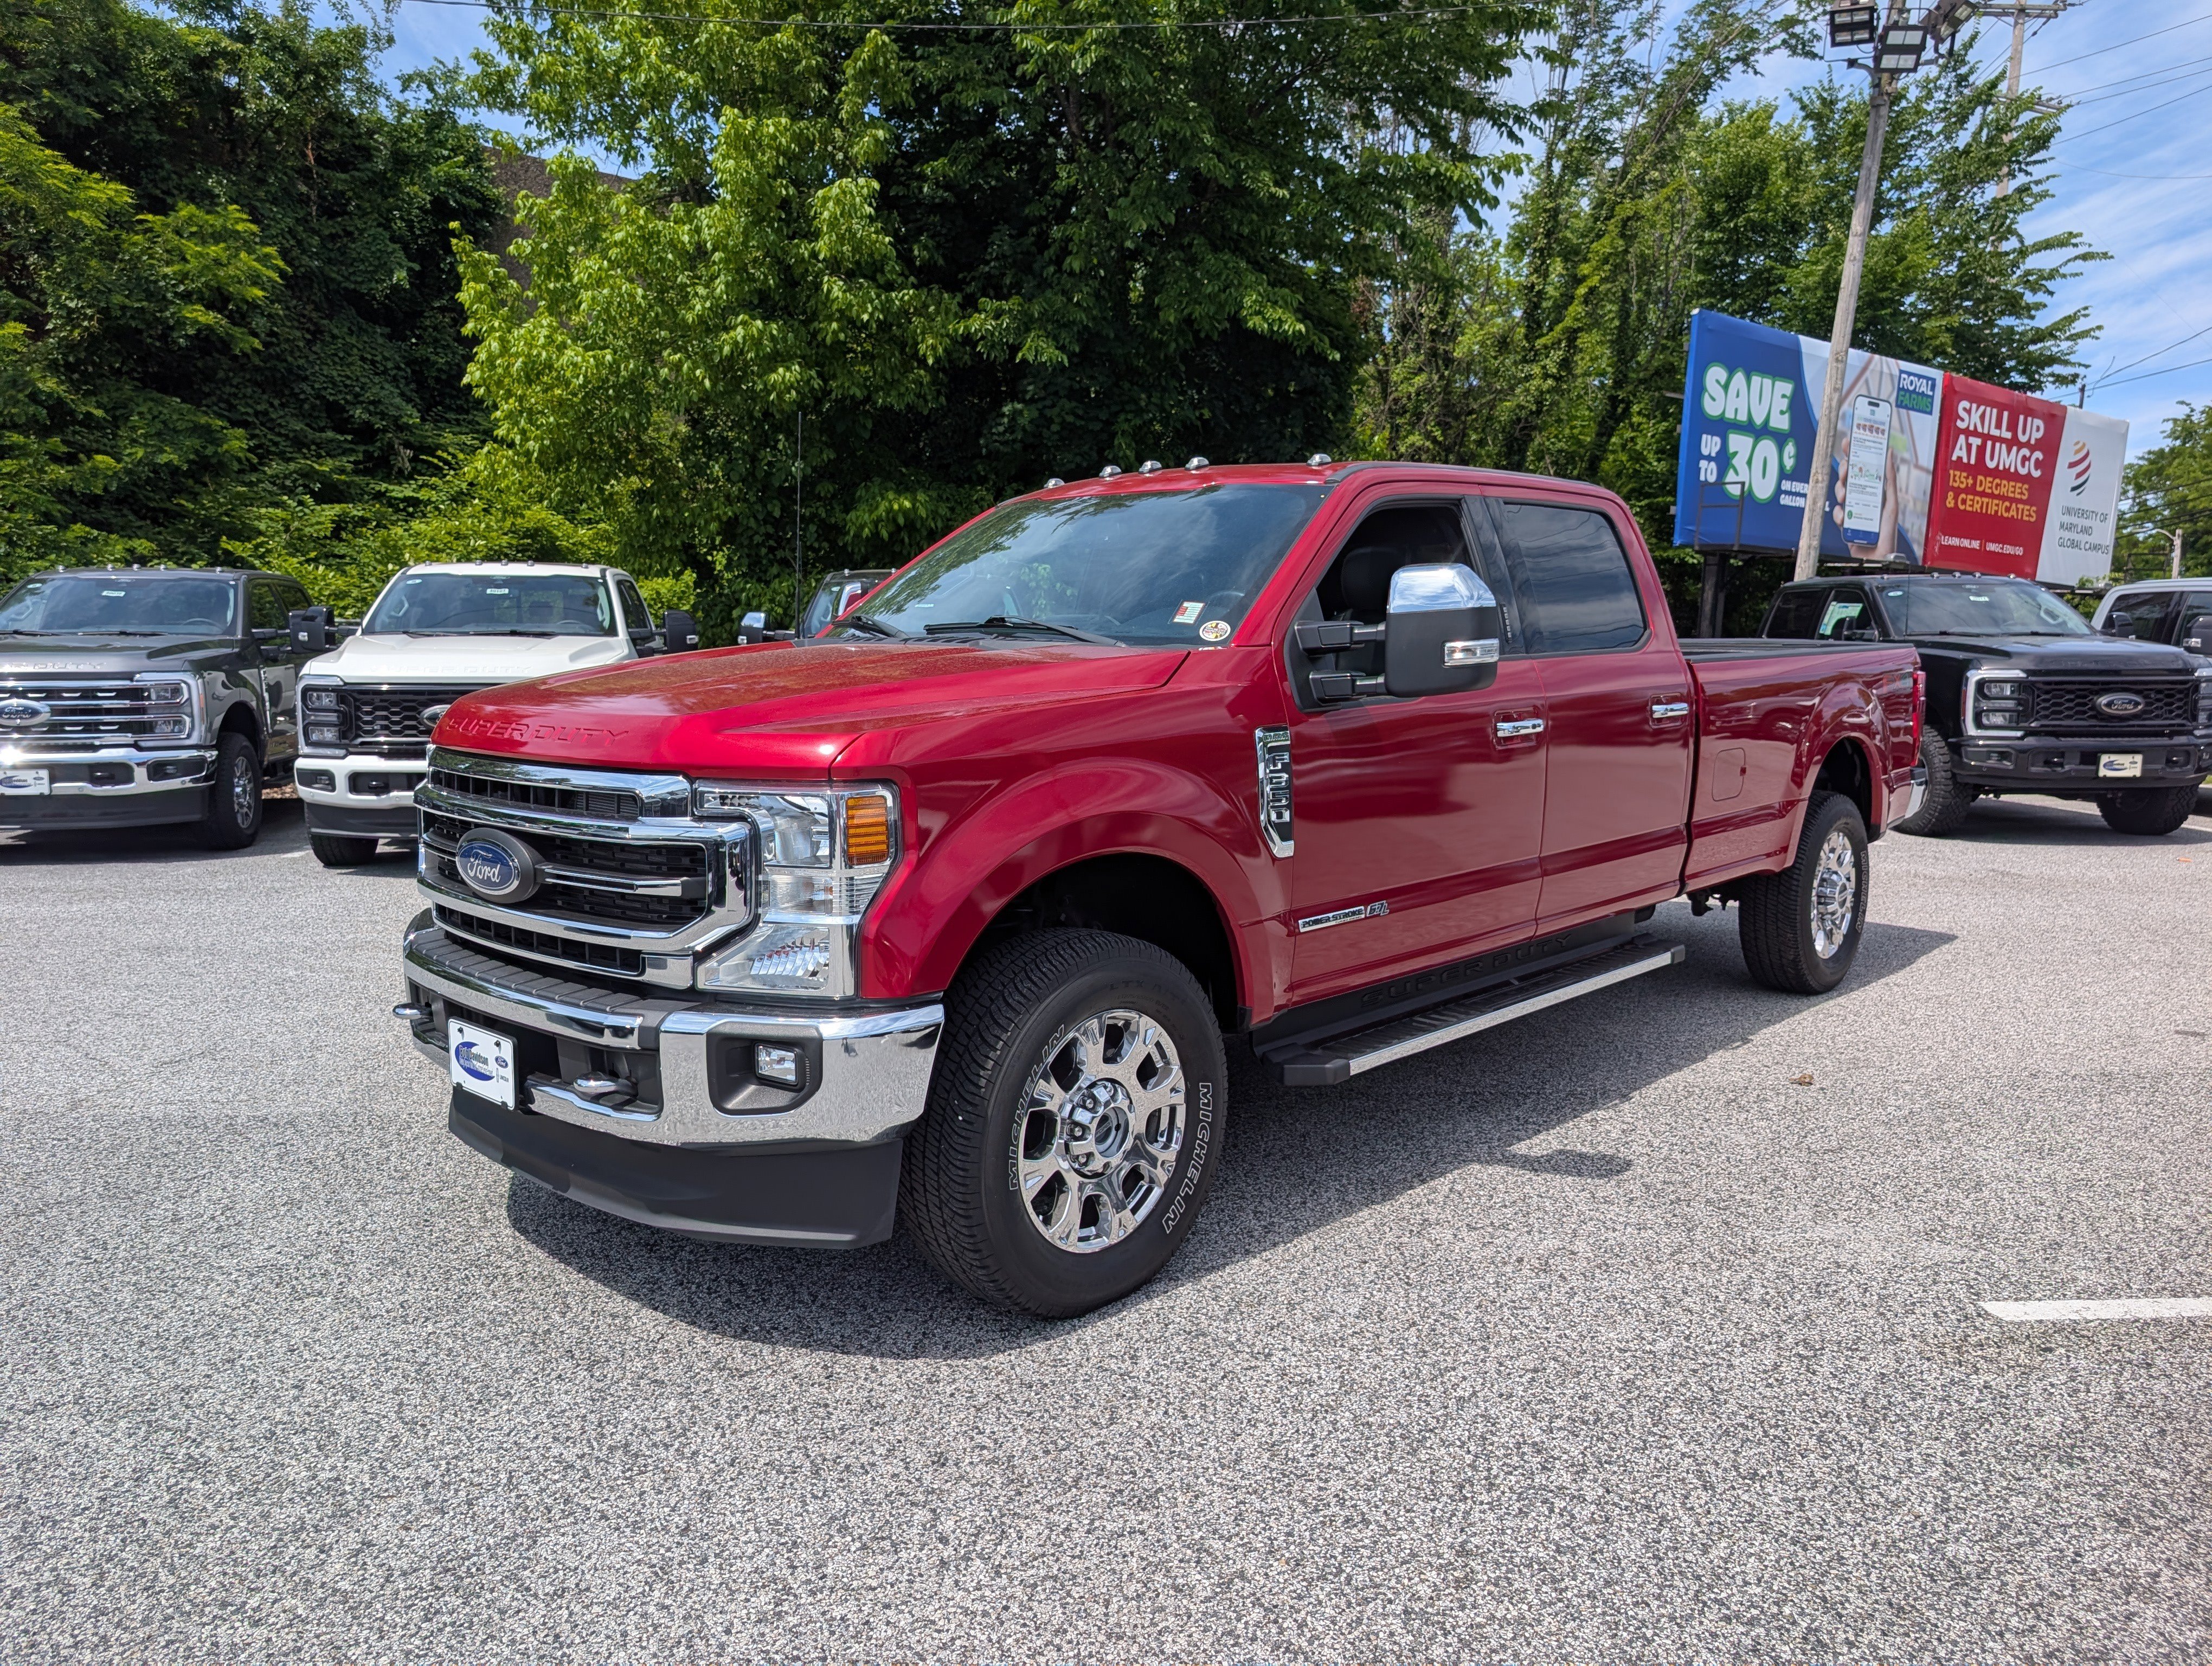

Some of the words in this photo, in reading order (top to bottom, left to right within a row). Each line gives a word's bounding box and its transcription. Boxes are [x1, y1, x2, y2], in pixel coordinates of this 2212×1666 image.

[1899, 374, 1933, 395] ROYAL
[1702, 364, 1794, 432] SAVE
[1898, 391, 1932, 412] FARMS
[1956, 400, 2012, 439] SKILL
[2017, 414, 2044, 445] UP
[1701, 434, 1721, 457] UP
[1951, 434, 1982, 465] AT
[1985, 440, 2043, 478] UMGC
[1699, 460, 1718, 483] TO
[1791, 481, 1809, 494] EVER
[1949, 469, 1973, 489] 135+
[1976, 475, 2029, 500] DEGREES
[1780, 494, 1805, 508] GALLON
[1946, 491, 1954, 508] &
[1958, 493, 2037, 522] CERTIFICATES
[2061, 505, 2098, 522] UNIVERSITY
[2099, 512, 2108, 524] OF
[2059, 521, 2093, 536] MARYLAND
[1941, 535, 1960, 547] LEARN
[1960, 537, 1980, 550] ONLINE
[1986, 542, 2023, 555] UMGC.EDU/GO
[2057, 537, 2082, 550] GLOBAL
[2084, 541, 2110, 554] CAMPUS
[2112, 699, 2134, 710] Ford
[446, 718, 529, 740] SUPER
[529, 725, 629, 747] DUTY
[468, 849, 501, 883] Ford
[1855, 850, 1867, 933] MICHELIN
[1302, 915, 1332, 928] POWER
[1331, 908, 1364, 922] STROKE
[1361, 960, 1484, 1008] SUPER
[1492, 933, 1572, 968] DUTY
[459, 1045, 470, 1058] Bob
[470, 1048, 489, 1067] Davidson
[497, 1057, 506, 1067] Ford
[1008, 1024, 1065, 1190] MICHELIN
[1162, 1082, 1212, 1234] MICHELIN
